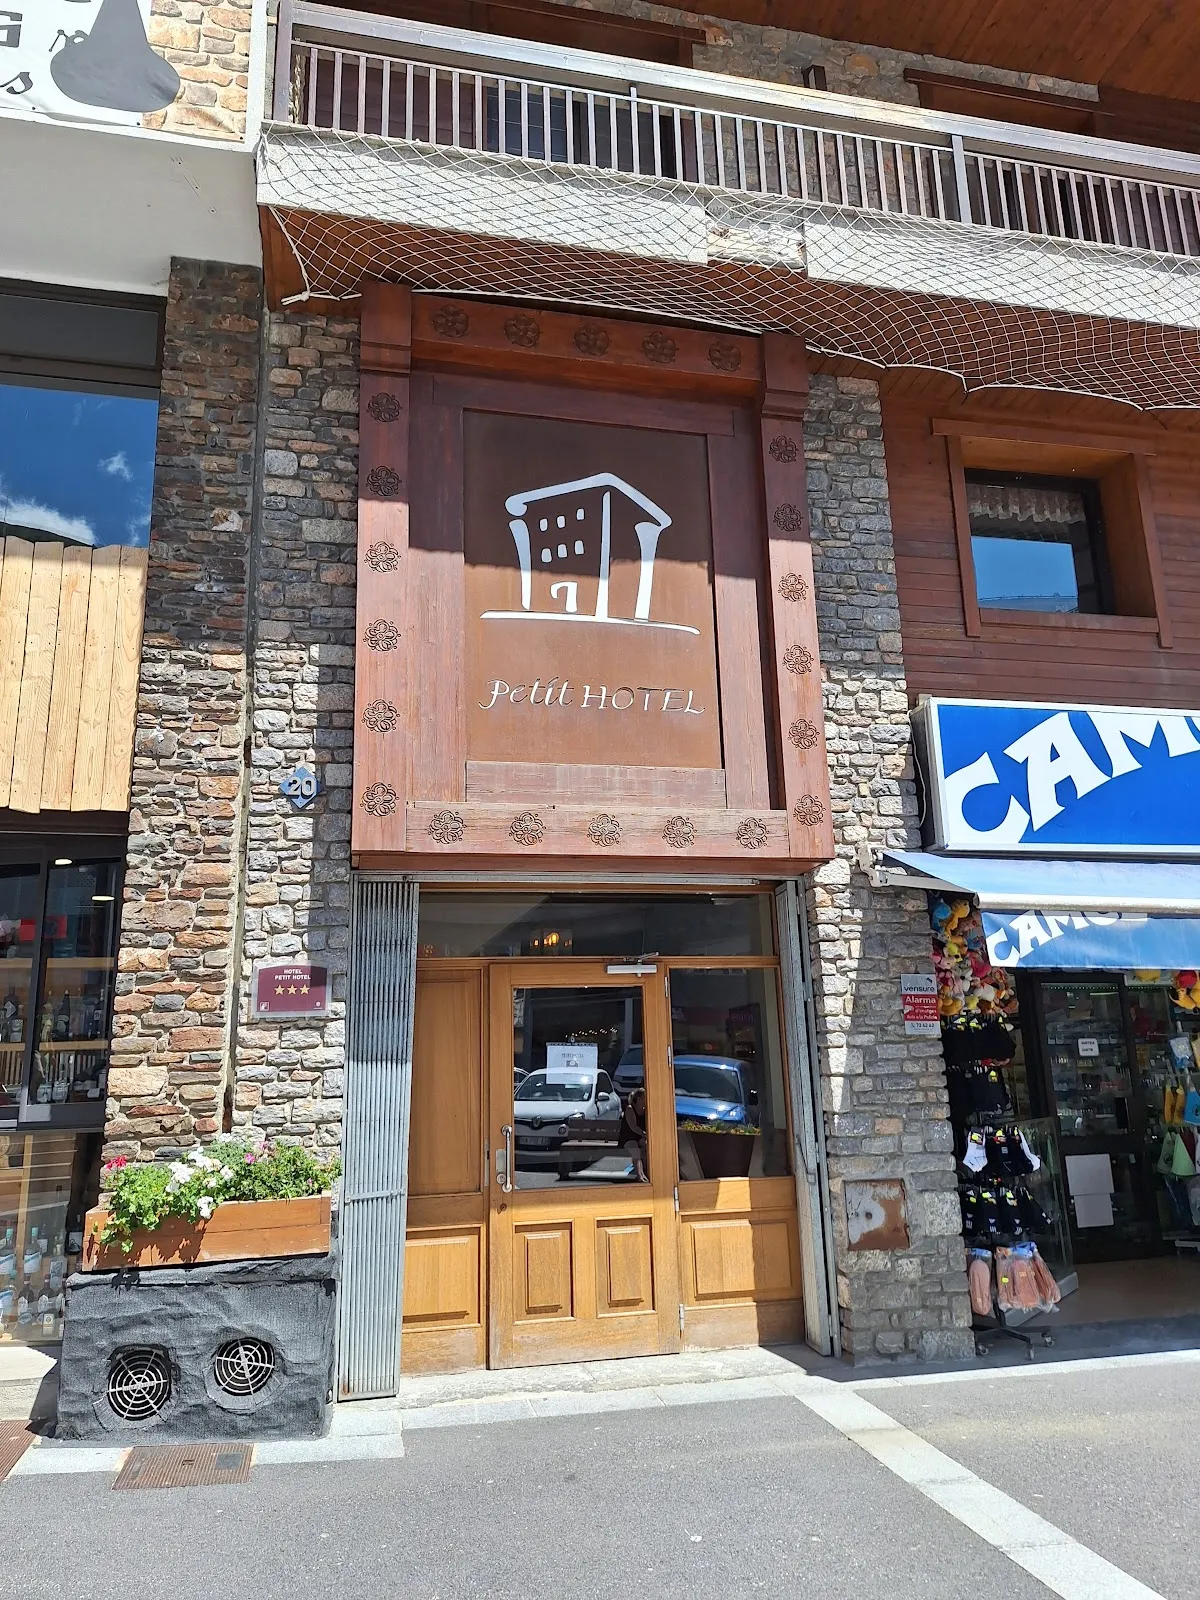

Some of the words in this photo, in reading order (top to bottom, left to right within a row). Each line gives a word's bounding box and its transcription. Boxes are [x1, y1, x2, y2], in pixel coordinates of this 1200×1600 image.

[478, 676, 574, 710] Petit
[579, 684, 706, 715] HOTEL
[288, 776, 316, 797] 20
[944, 711, 1200, 844] CAM
[906, 995, 936, 1004] Alarma
